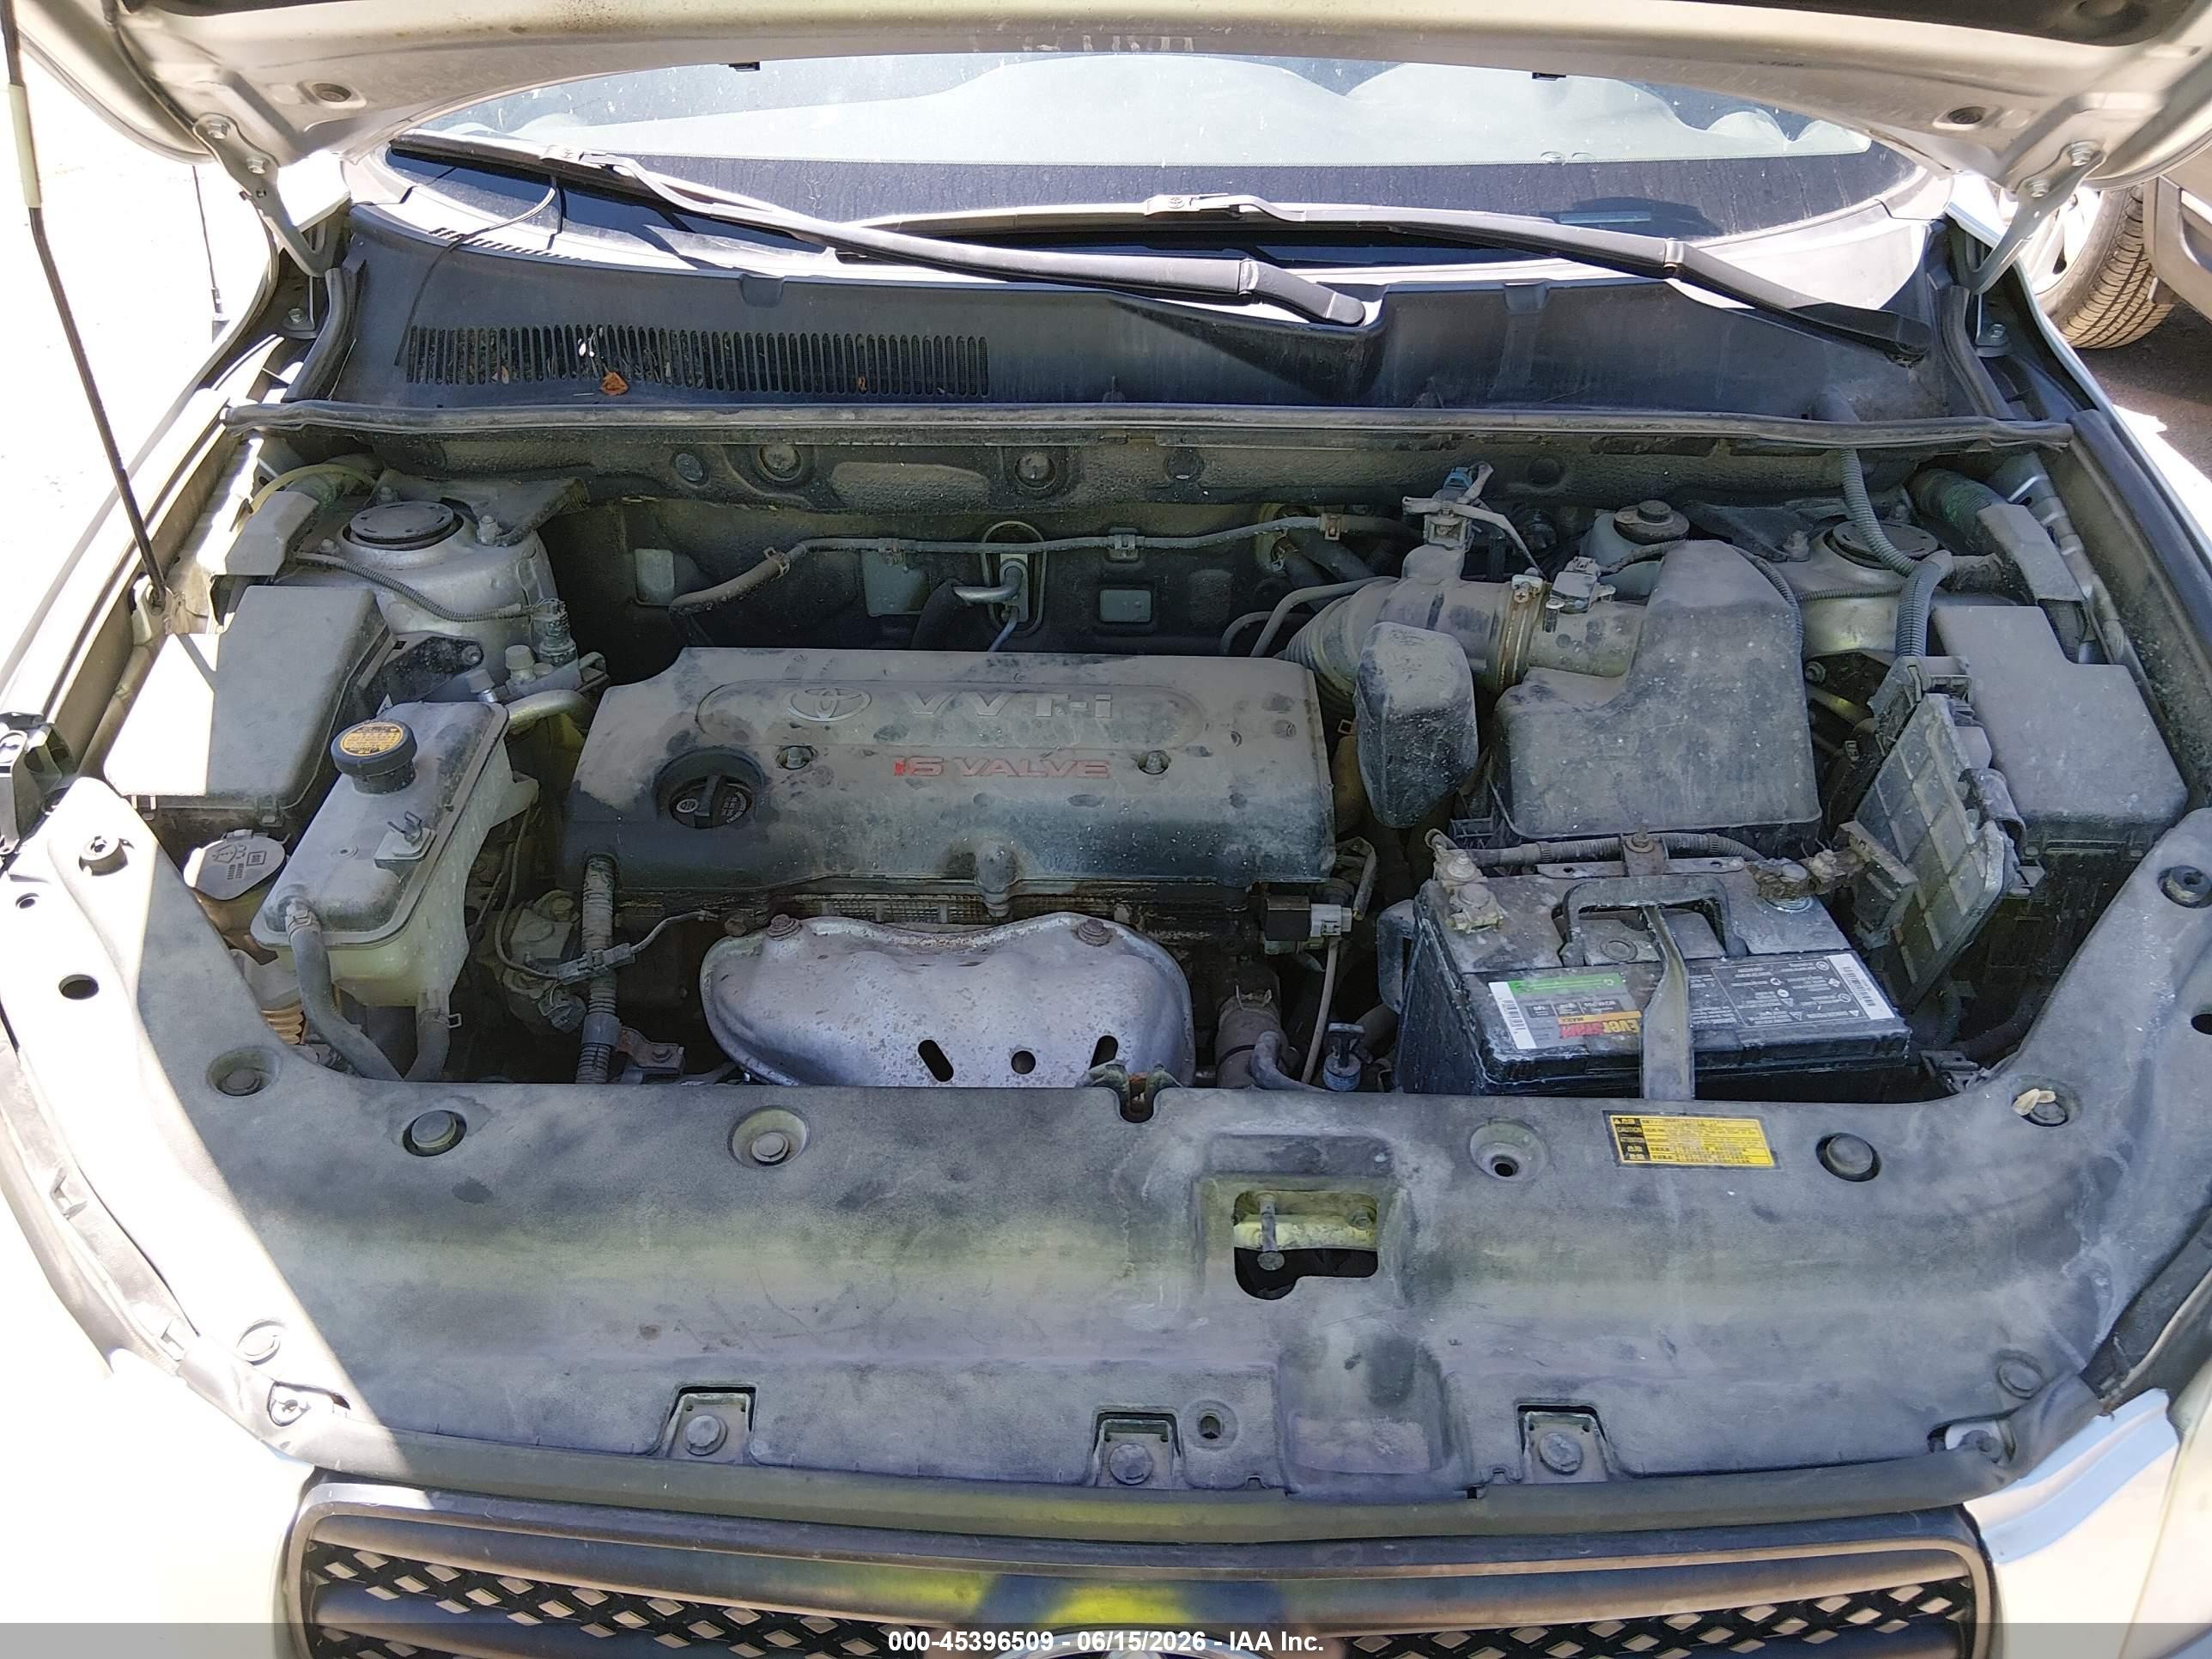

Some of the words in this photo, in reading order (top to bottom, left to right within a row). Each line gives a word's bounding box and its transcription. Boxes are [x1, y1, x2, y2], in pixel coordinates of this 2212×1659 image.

[904, 692, 1111, 719] VVT-i
[954, 757, 1110, 779] VALVE
[1559, 1018, 1641, 1039] EverStart
